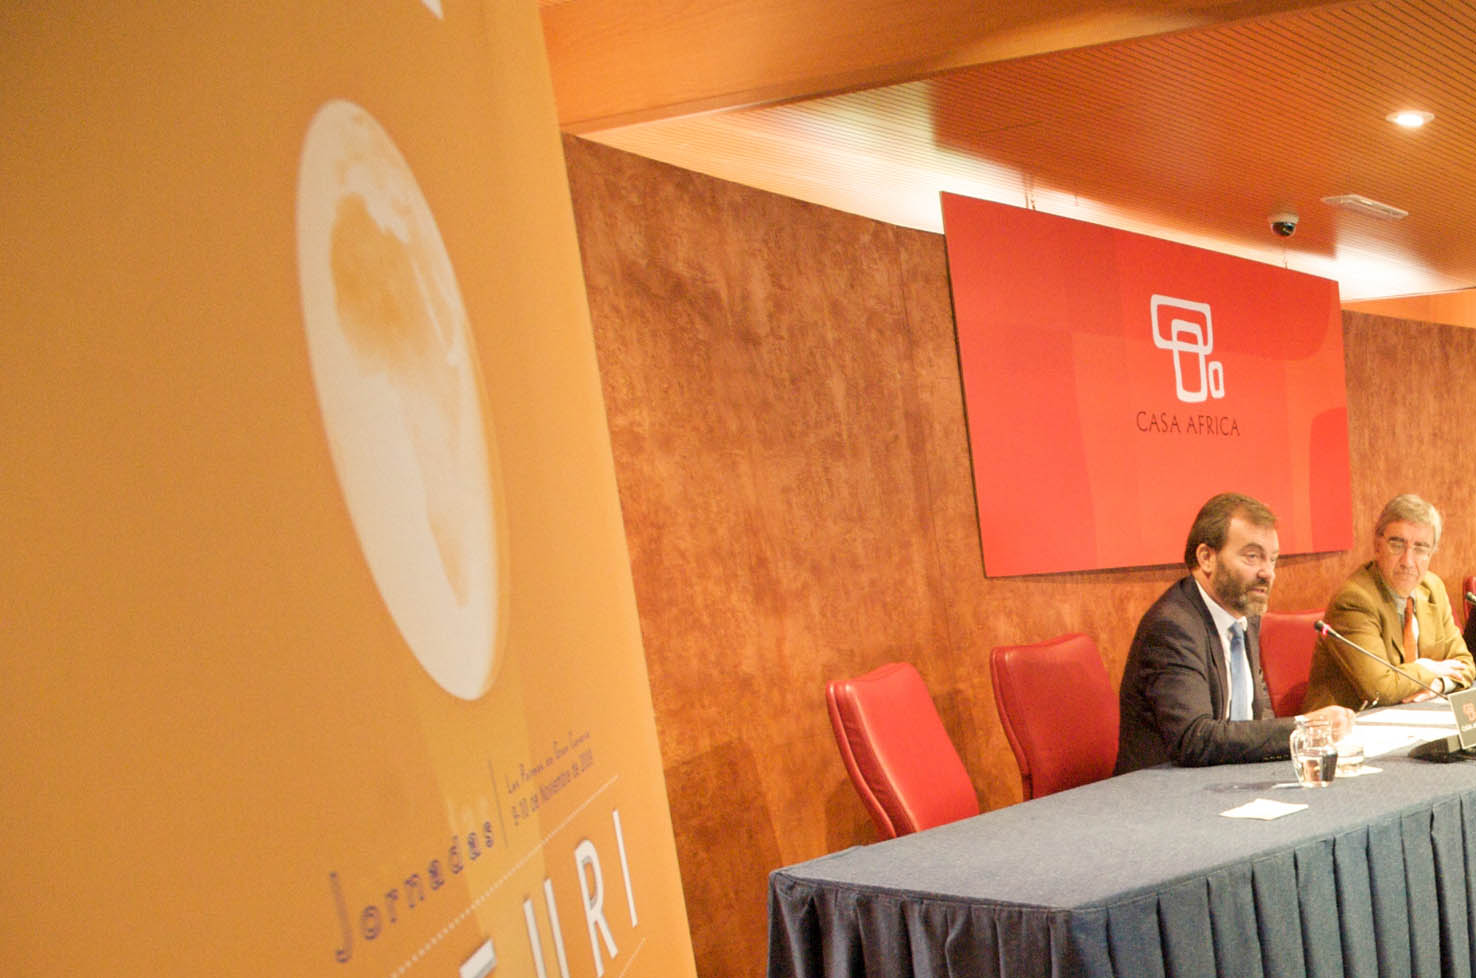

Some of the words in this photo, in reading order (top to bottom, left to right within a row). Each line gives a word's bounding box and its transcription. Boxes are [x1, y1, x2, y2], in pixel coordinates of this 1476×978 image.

[1136, 411, 1181, 433] CASA
[1186, 415, 1241, 437] AFRICA
[329, 821, 494, 963] Jornadas
